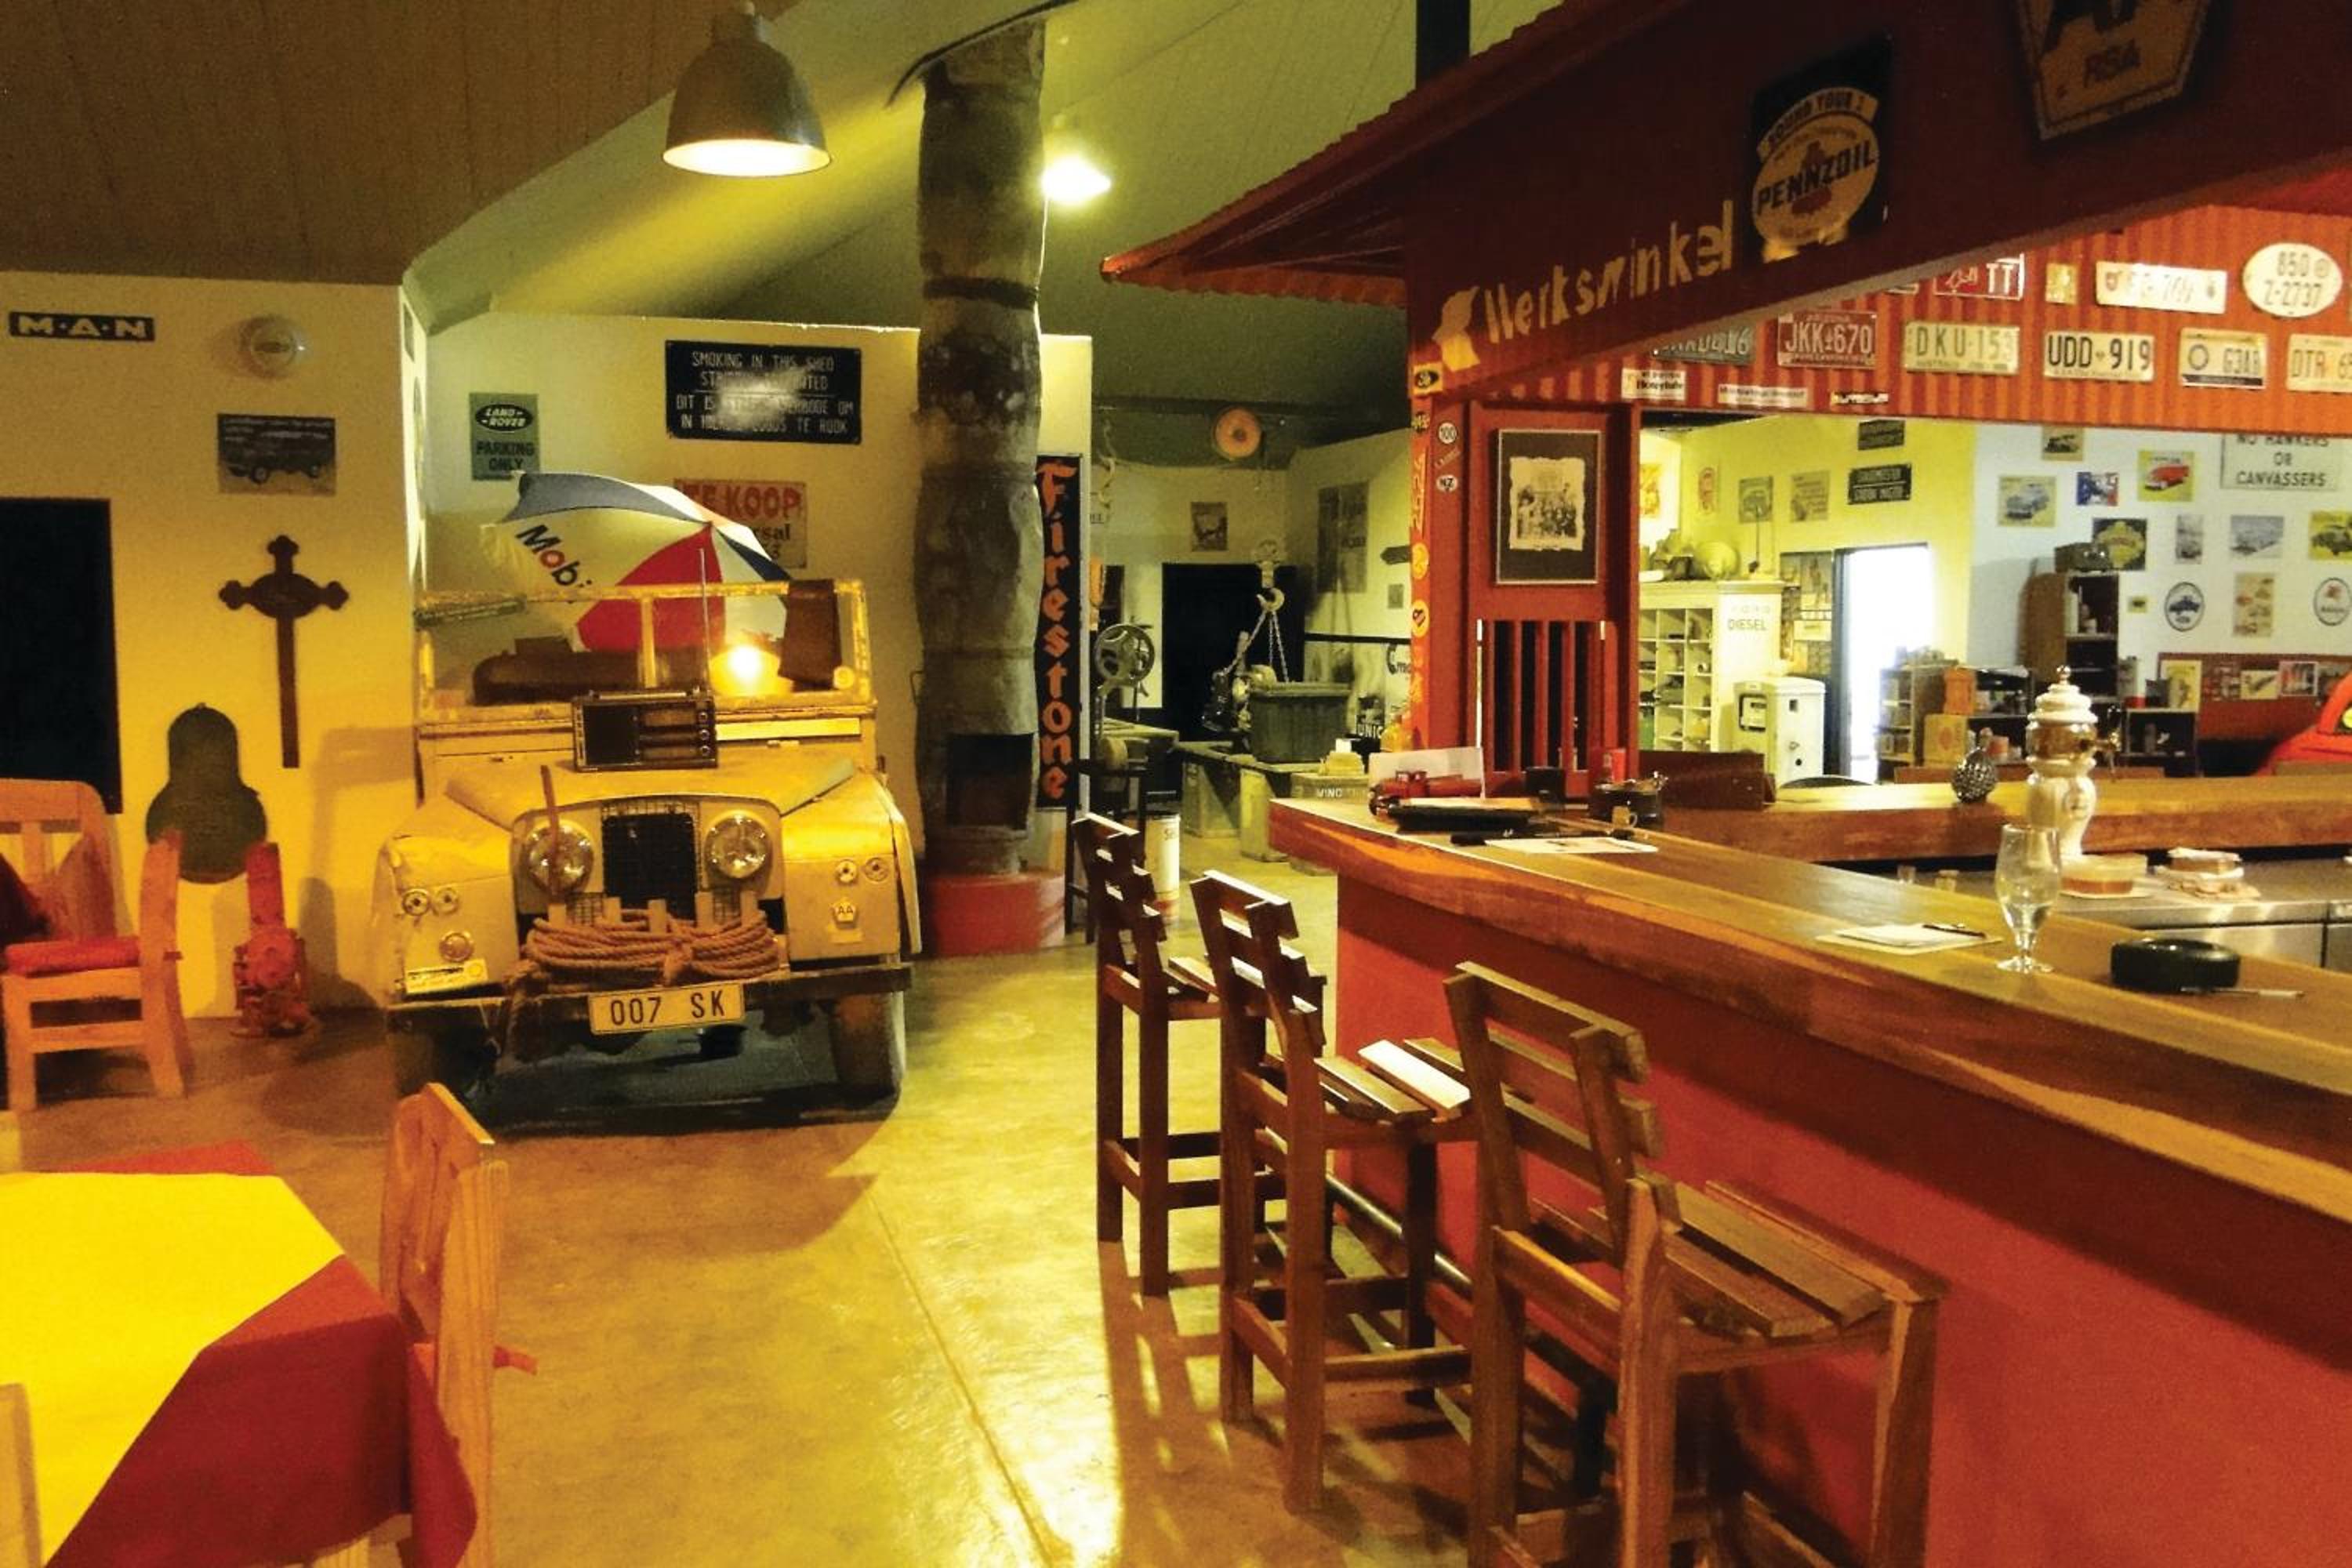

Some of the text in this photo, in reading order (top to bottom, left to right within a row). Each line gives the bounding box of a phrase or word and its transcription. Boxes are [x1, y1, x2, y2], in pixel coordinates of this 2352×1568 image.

[1757, 140, 1874, 216] PENNZOIL
[691, 352, 834, 372] SMOKING IN THIS SHED
[676, 394, 695, 410] DIT
[681, 414, 692, 428] IN
[476, 441, 535, 456] PARKING
[488, 458, 524, 470] ONLY
[2274, 452, 2292, 466] OR
[2236, 470, 2326, 487] CANVASSERS
[727, 485, 800, 518] KOOP
[1035, 461, 1077, 800] Firestone
[610, 989, 725, 1025] 007 SK
